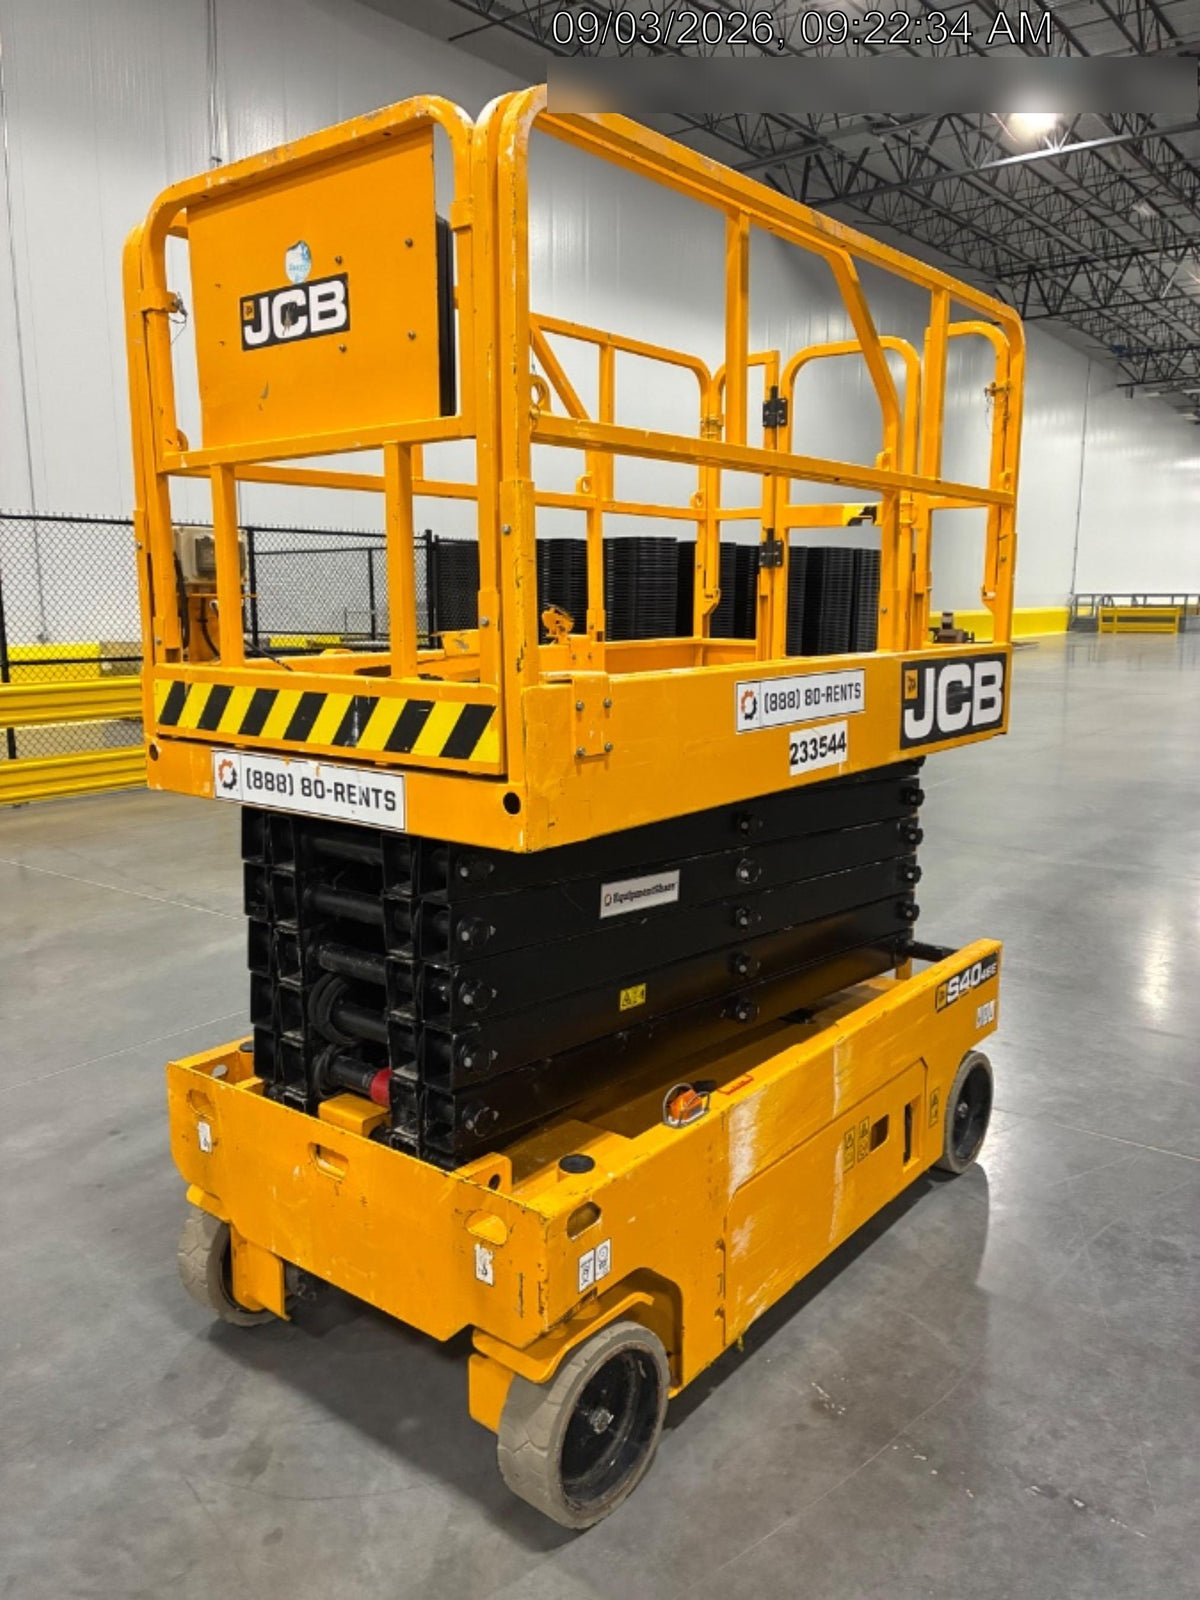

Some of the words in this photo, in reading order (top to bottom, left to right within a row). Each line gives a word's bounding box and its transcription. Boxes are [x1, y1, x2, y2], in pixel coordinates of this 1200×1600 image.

[244, 280, 347, 345] JCB
[765, 689, 800, 714] (888)
[804, 682, 862, 706] 80-RENTS
[904, 660, 1003, 739] JCB
[789, 731, 847, 766] 233544
[246, 767, 294, 796] (888)
[301, 777, 396, 812] 80-RENTS
